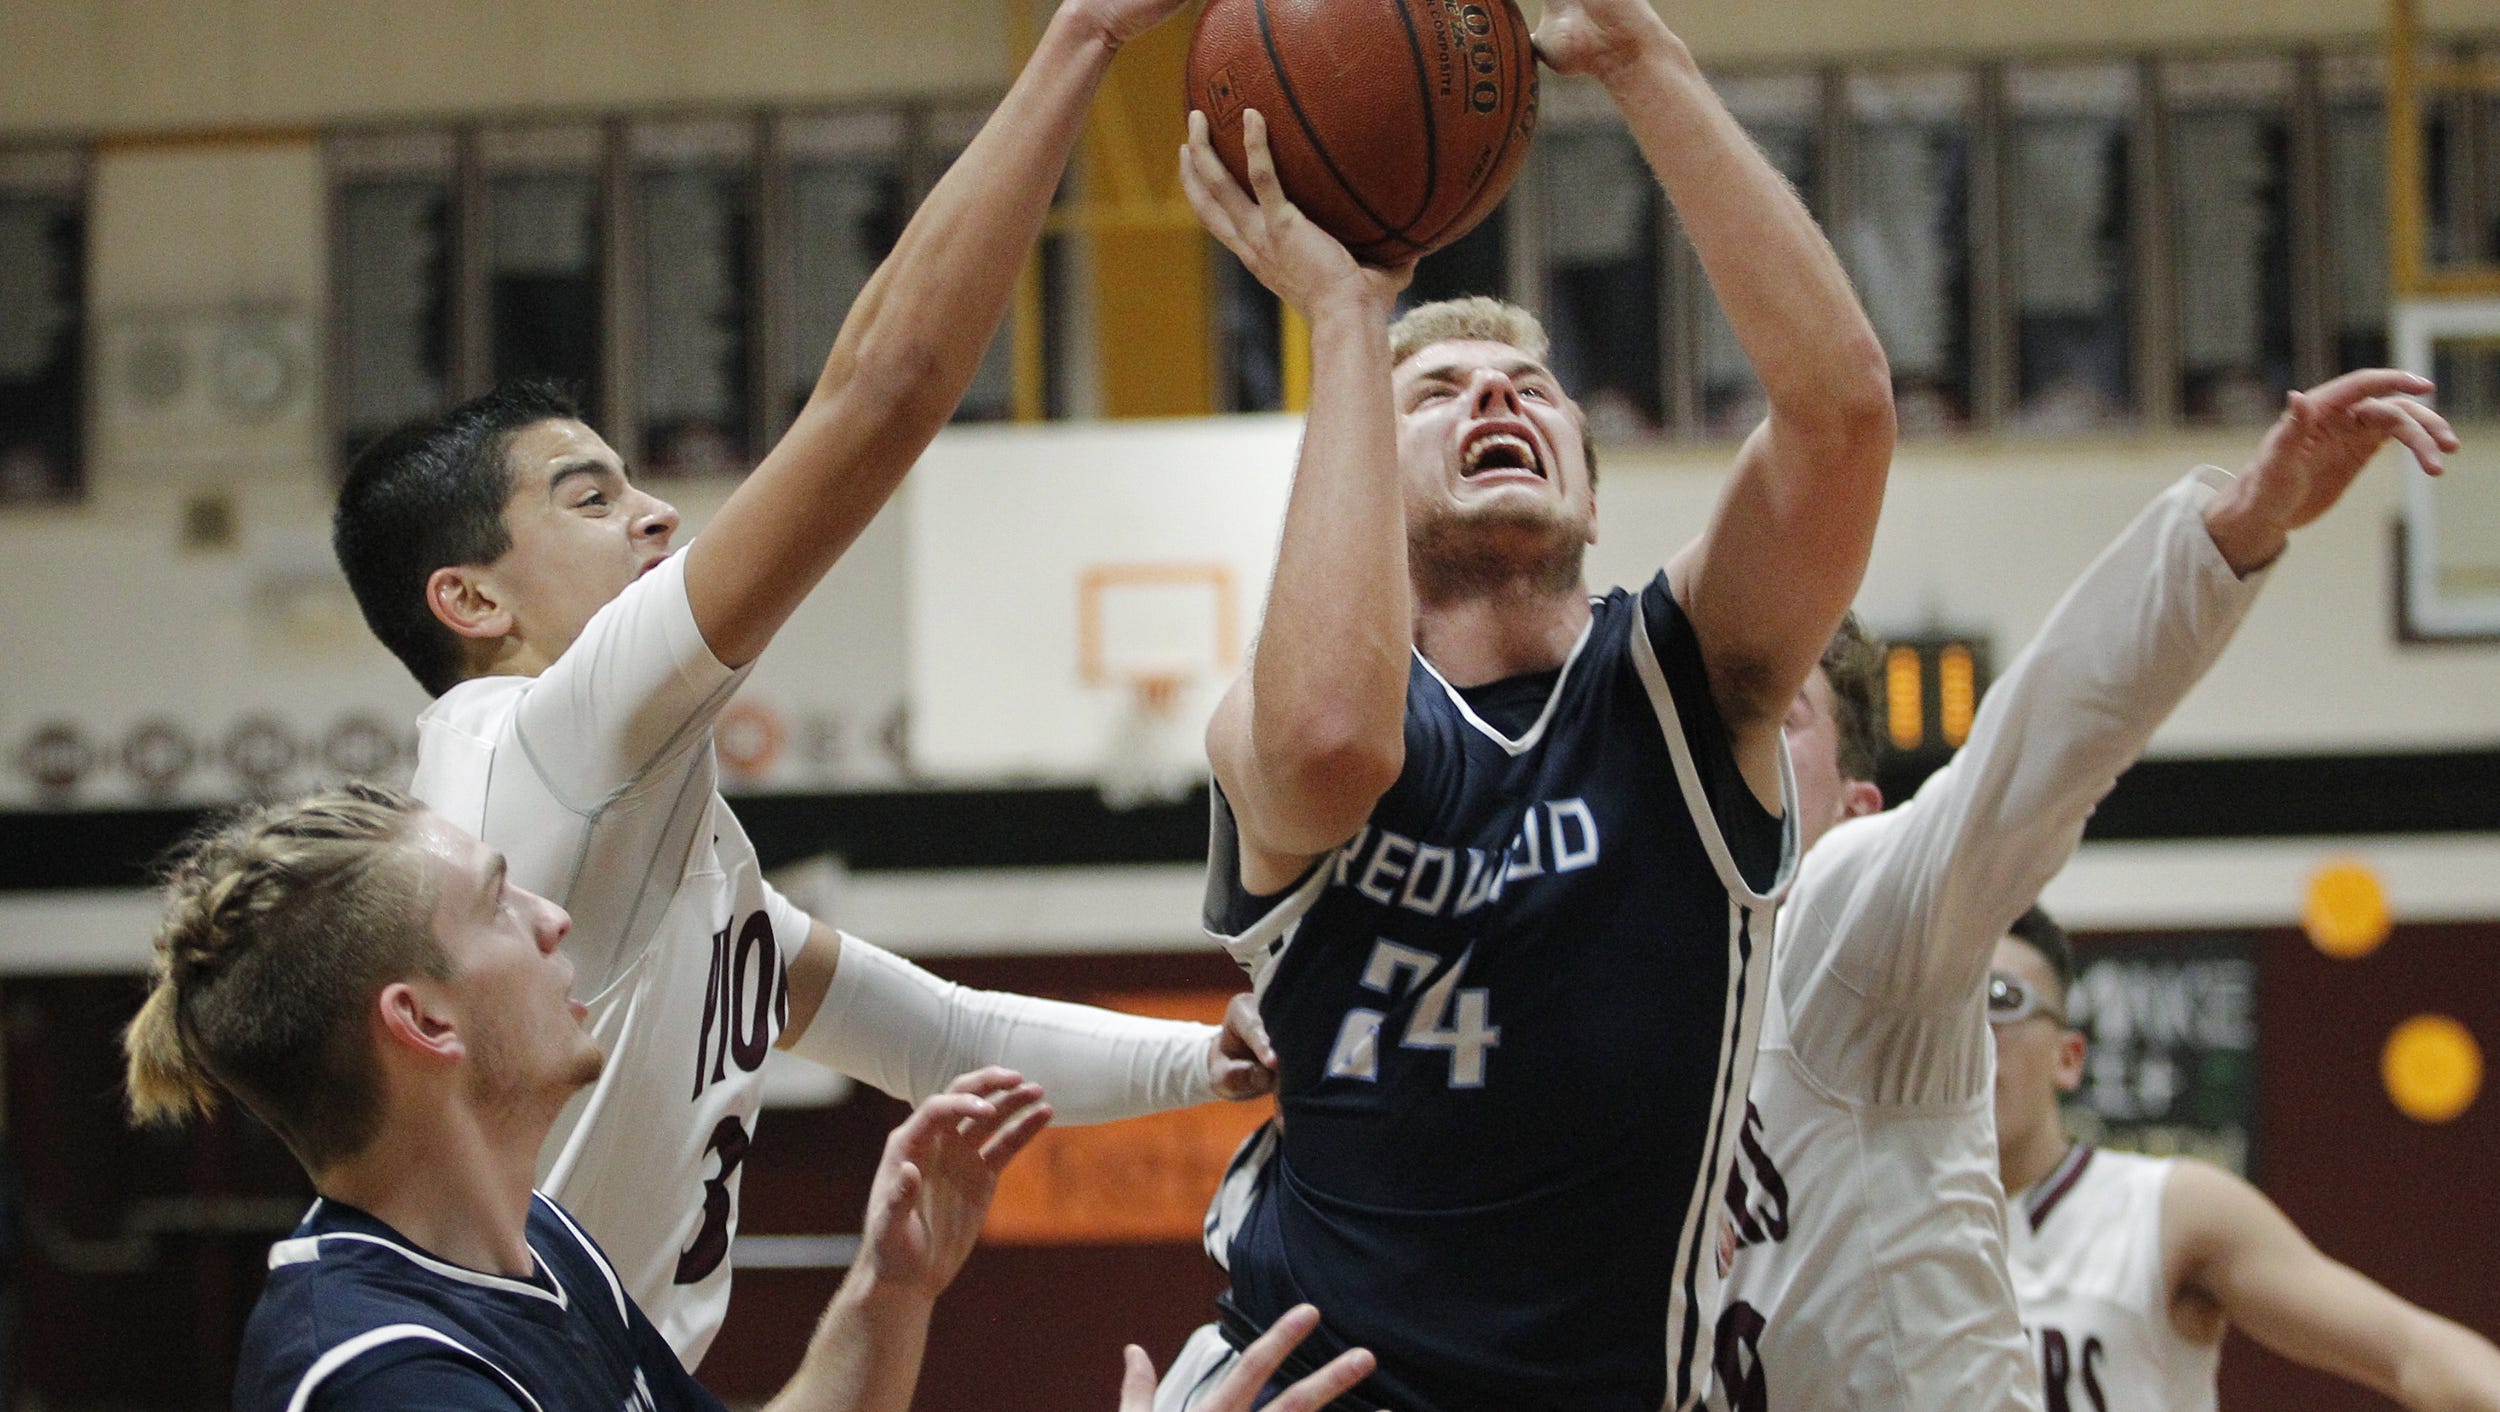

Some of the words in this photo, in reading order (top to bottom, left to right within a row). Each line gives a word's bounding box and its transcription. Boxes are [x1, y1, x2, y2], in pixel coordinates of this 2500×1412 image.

[1431, 10, 1452, 97] COMPOSITE
[1886, 644, 1974, 749] 11
[1324, 935, 1502, 1090] 24
